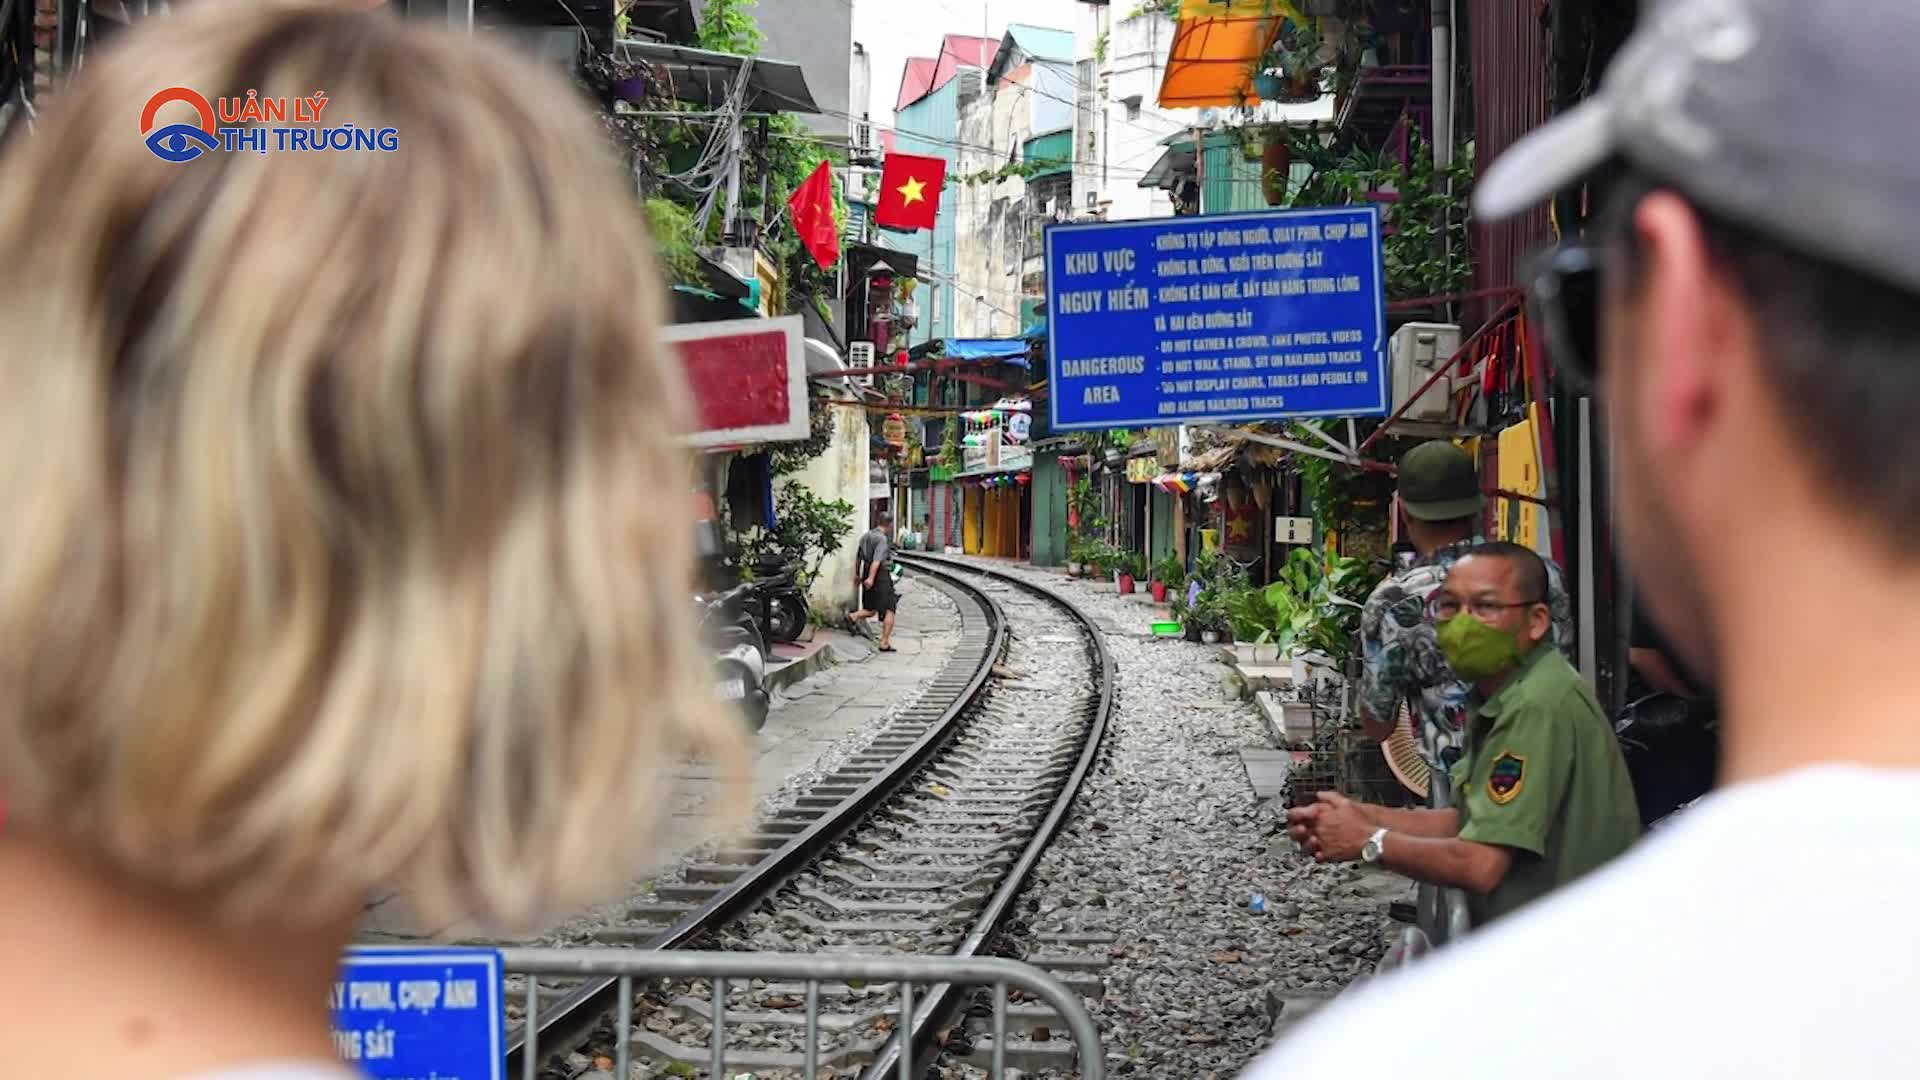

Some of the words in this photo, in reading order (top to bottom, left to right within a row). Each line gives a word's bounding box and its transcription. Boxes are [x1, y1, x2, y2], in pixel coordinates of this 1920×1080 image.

[1156, 232, 1186, 250] KHÔNG
[1187, 232, 1198, 252] TỤ
[1200, 229, 1216, 251] TẬP
[1273, 227, 1296, 244] QUAY
[1324, 223, 1348, 243] CHỤP
[1065, 252, 1099, 276] KHU
[1103, 248, 1136, 278] VỰC
[1158, 258, 1186, 276] KHÔNG
[1059, 290, 1102, 315] NGUY
[1159, 284, 1187, 303] KHÔNG
[1154, 313, 1167, 333] VÀ
[1160, 340, 1173, 353] DO
[1174, 339, 1191, 352] NOT
[1192, 337, 1226, 351] GATHER
[1227, 336, 1234, 350] A
[1331, 329, 1362, 344] VIDEOS
[1062, 355, 1145, 378] DANGEROUS
[1161, 360, 1174, 374] DO
[1175, 359, 1192, 373] NOT
[1255, 355, 1268, 369] SIT
[1270, 354, 1283, 368] ON
[1284, 353, 1327, 367] RAILROAD
[1327, 350, 1362, 364] TRACKS
[1083, 385, 1121, 405] AREA
[1176, 380, 1193, 394] NOT
[1194, 378, 1230, 393] DISPLAY
[1267, 374, 1299, 389] TABLES
[1300, 373, 1319, 387] AND
[1158, 400, 1176, 415] AND
[1177, 399, 1206, 413] ALONG
[1250, 395, 1284, 409] TRACKS
[398, 979, 441, 1016] CHỤP
